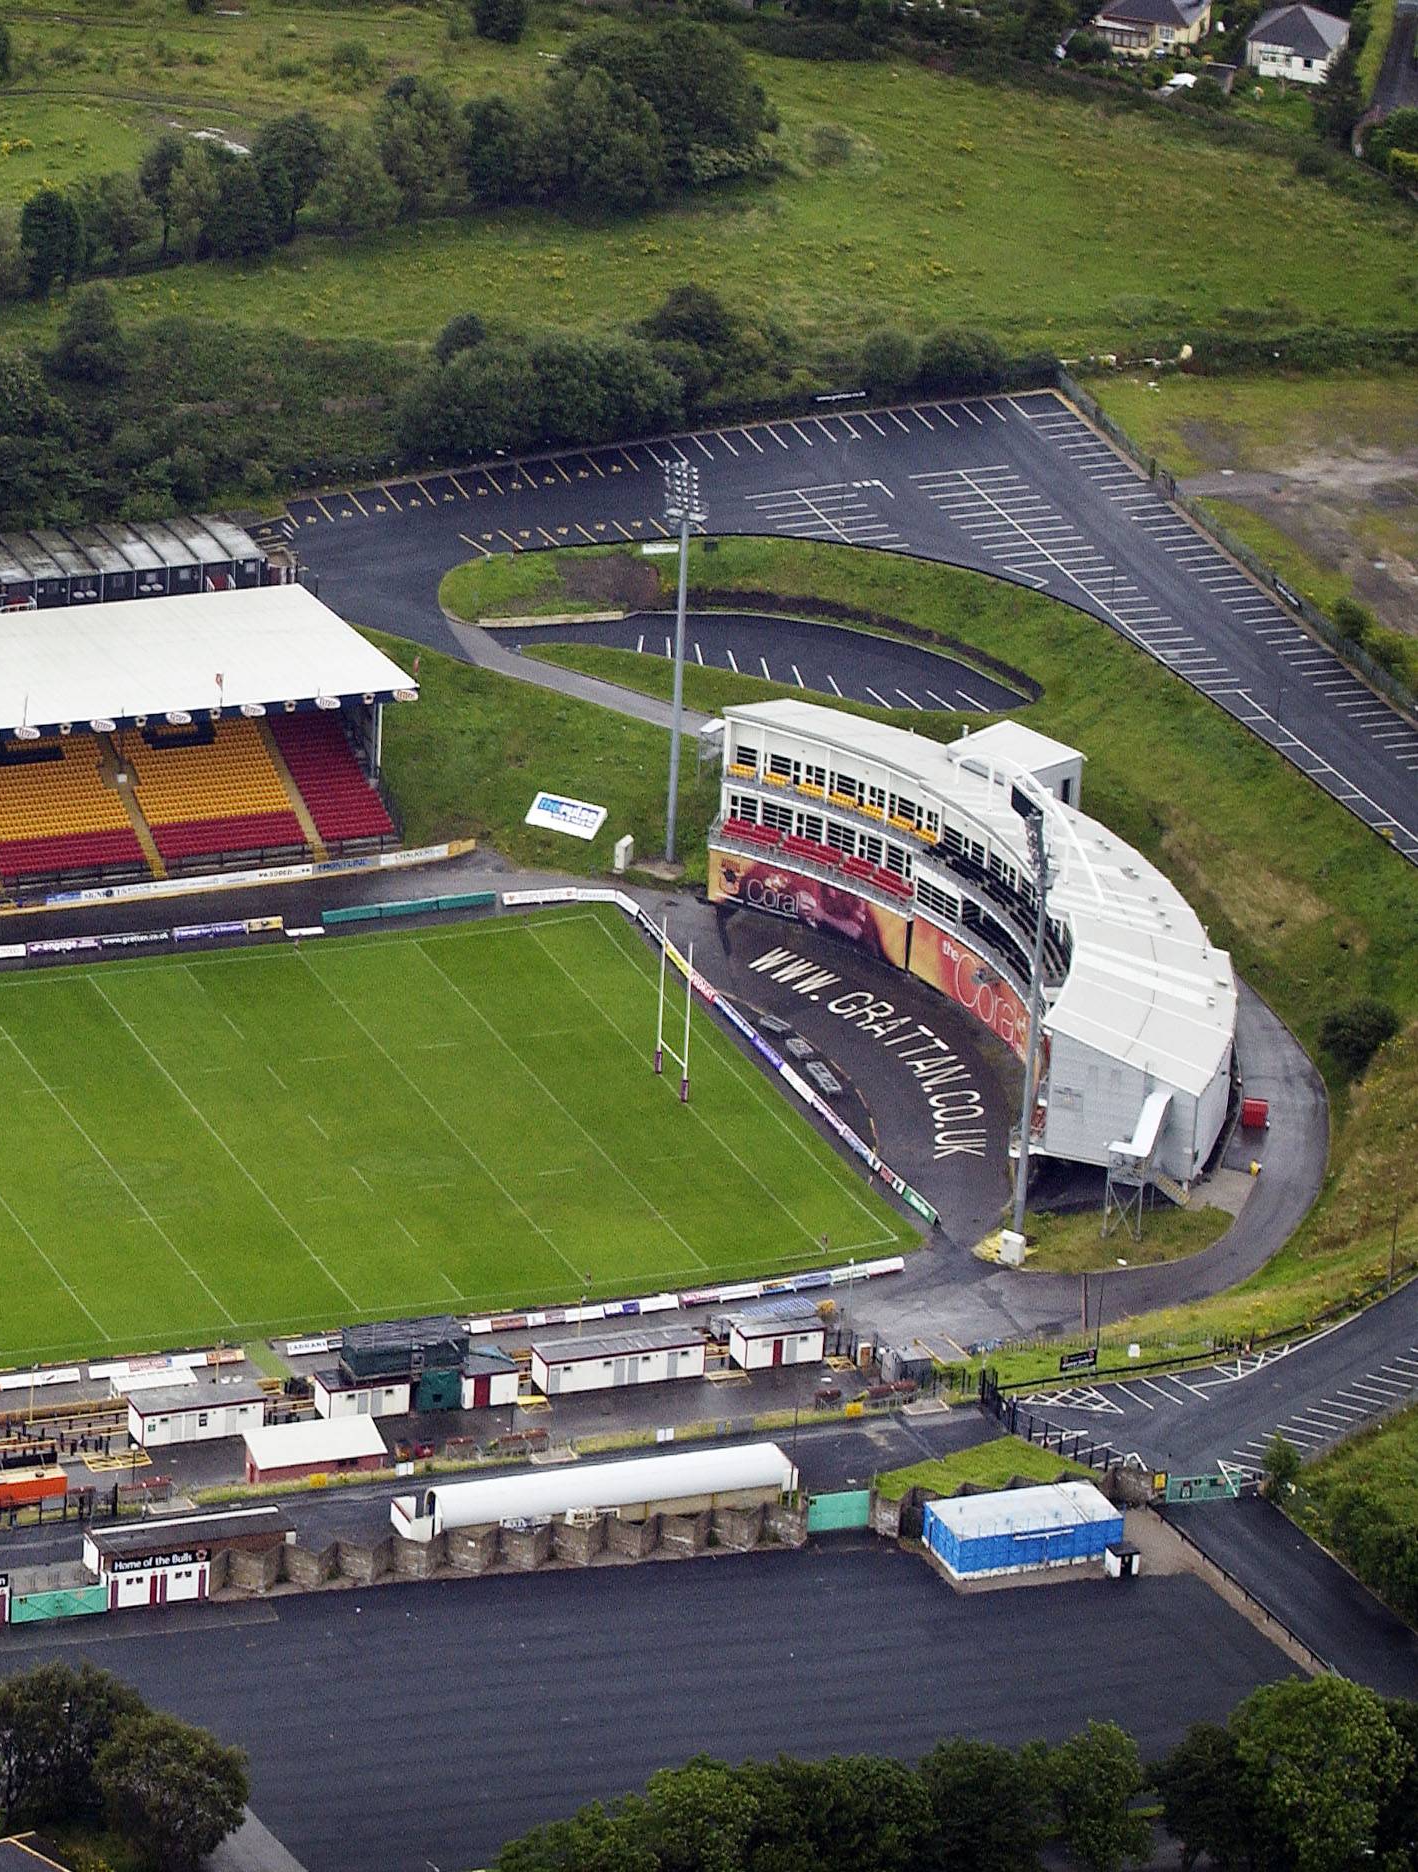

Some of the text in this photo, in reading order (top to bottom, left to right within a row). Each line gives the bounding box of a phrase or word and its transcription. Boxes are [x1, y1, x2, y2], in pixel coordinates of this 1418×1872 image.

[747, 879, 799, 914] Coral
[942, 941, 1019, 1049] the Coral
[114, 1552, 193, 1572] Home of the Bulls
